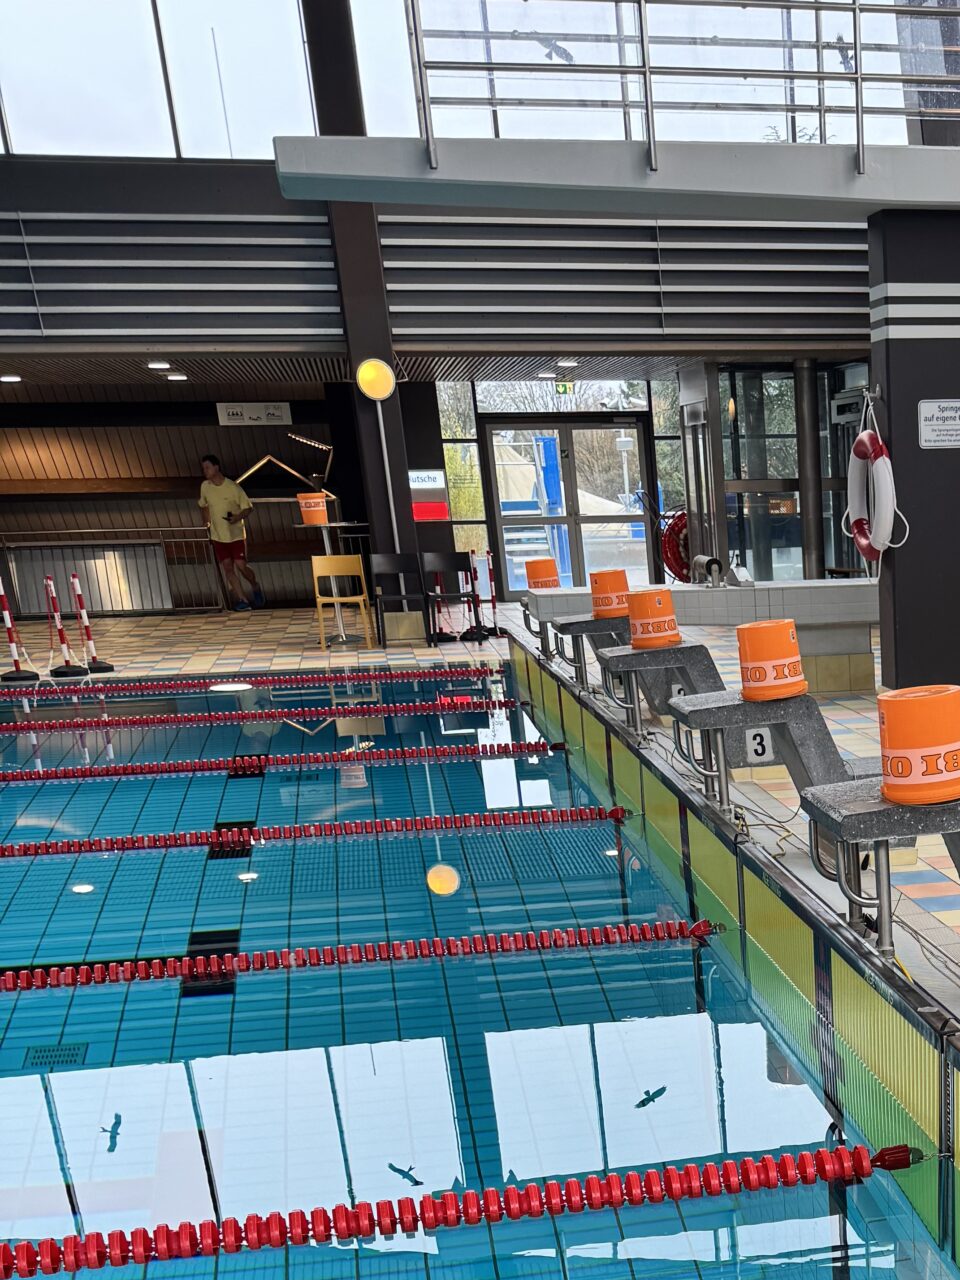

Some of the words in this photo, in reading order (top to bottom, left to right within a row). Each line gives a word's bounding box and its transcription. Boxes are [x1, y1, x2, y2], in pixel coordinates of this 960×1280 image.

[923, 414, 935, 422] auf
[936, 414, 957, 424] eigene
[410, 474, 438, 484] utsche
[752, 732, 767, 757] 3
